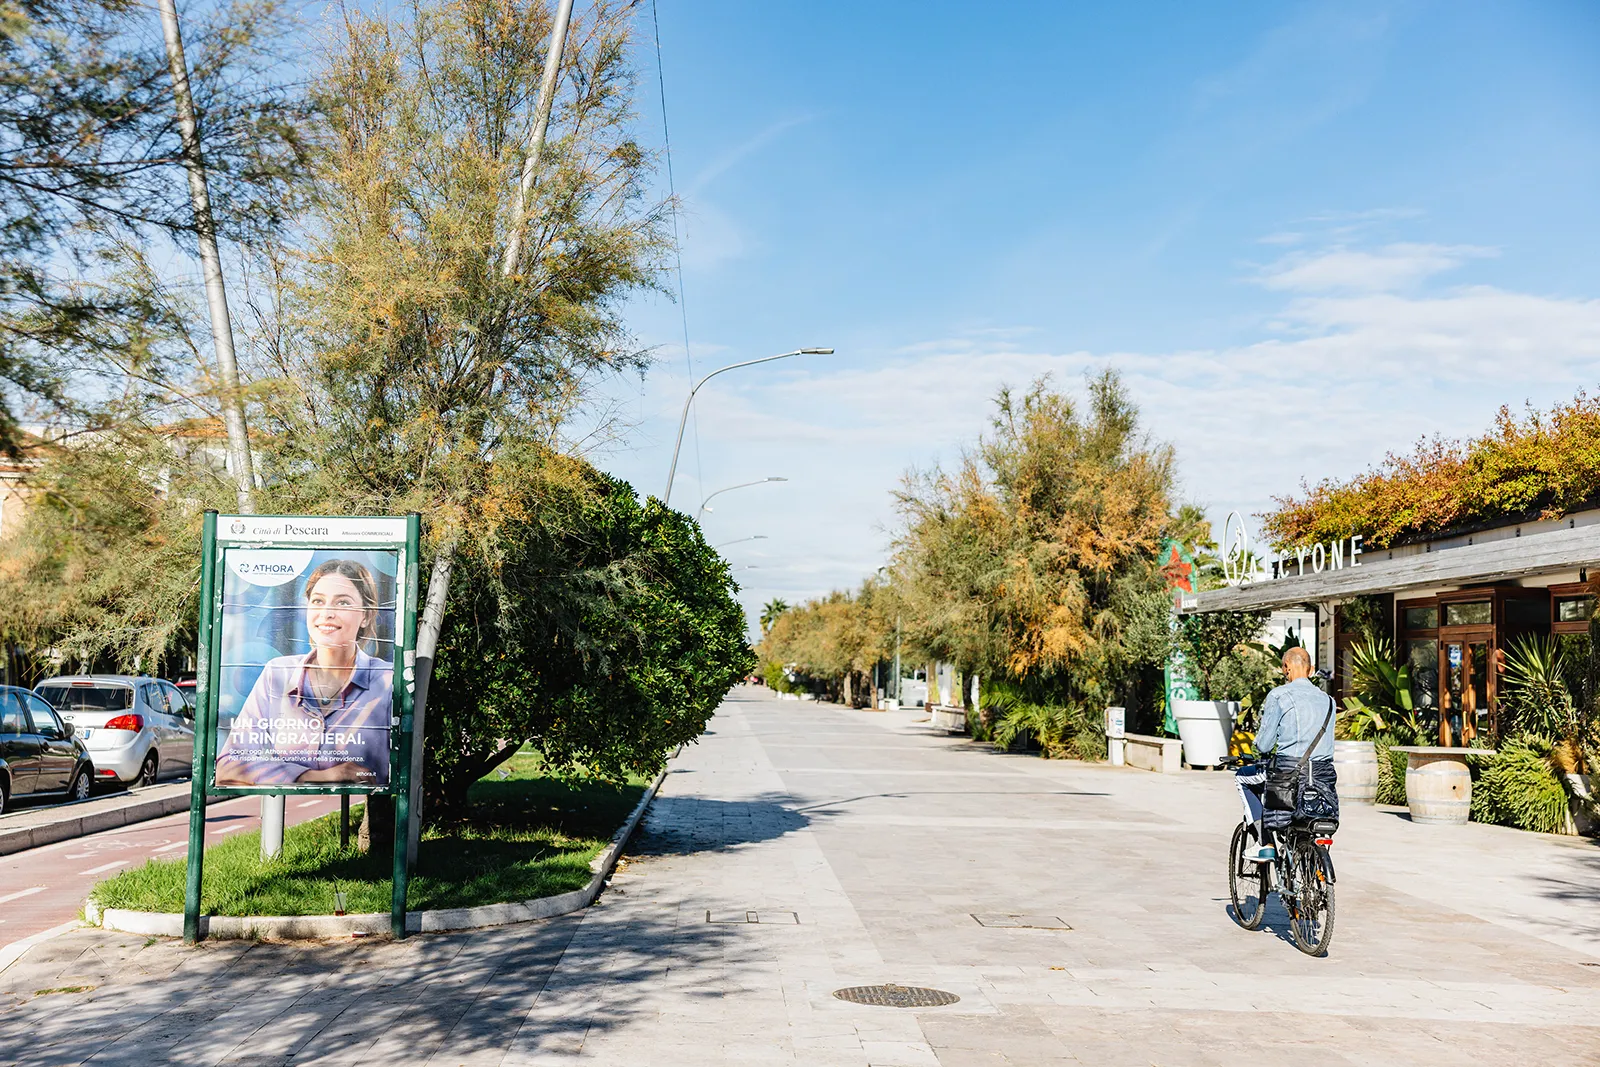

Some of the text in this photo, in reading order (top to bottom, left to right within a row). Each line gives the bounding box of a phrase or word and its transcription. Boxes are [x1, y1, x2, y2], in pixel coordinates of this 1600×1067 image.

[252, 524, 329, 536] Città di Pescara
[1248, 533, 1363, 584] ALCYONE
[252, 564, 295, 573] ATHORA
[230, 717, 321, 730] UN GIORNO
[230, 732, 366, 745] TI RINGRAZIERAI.
[265, 748, 288, 756] Athora,
